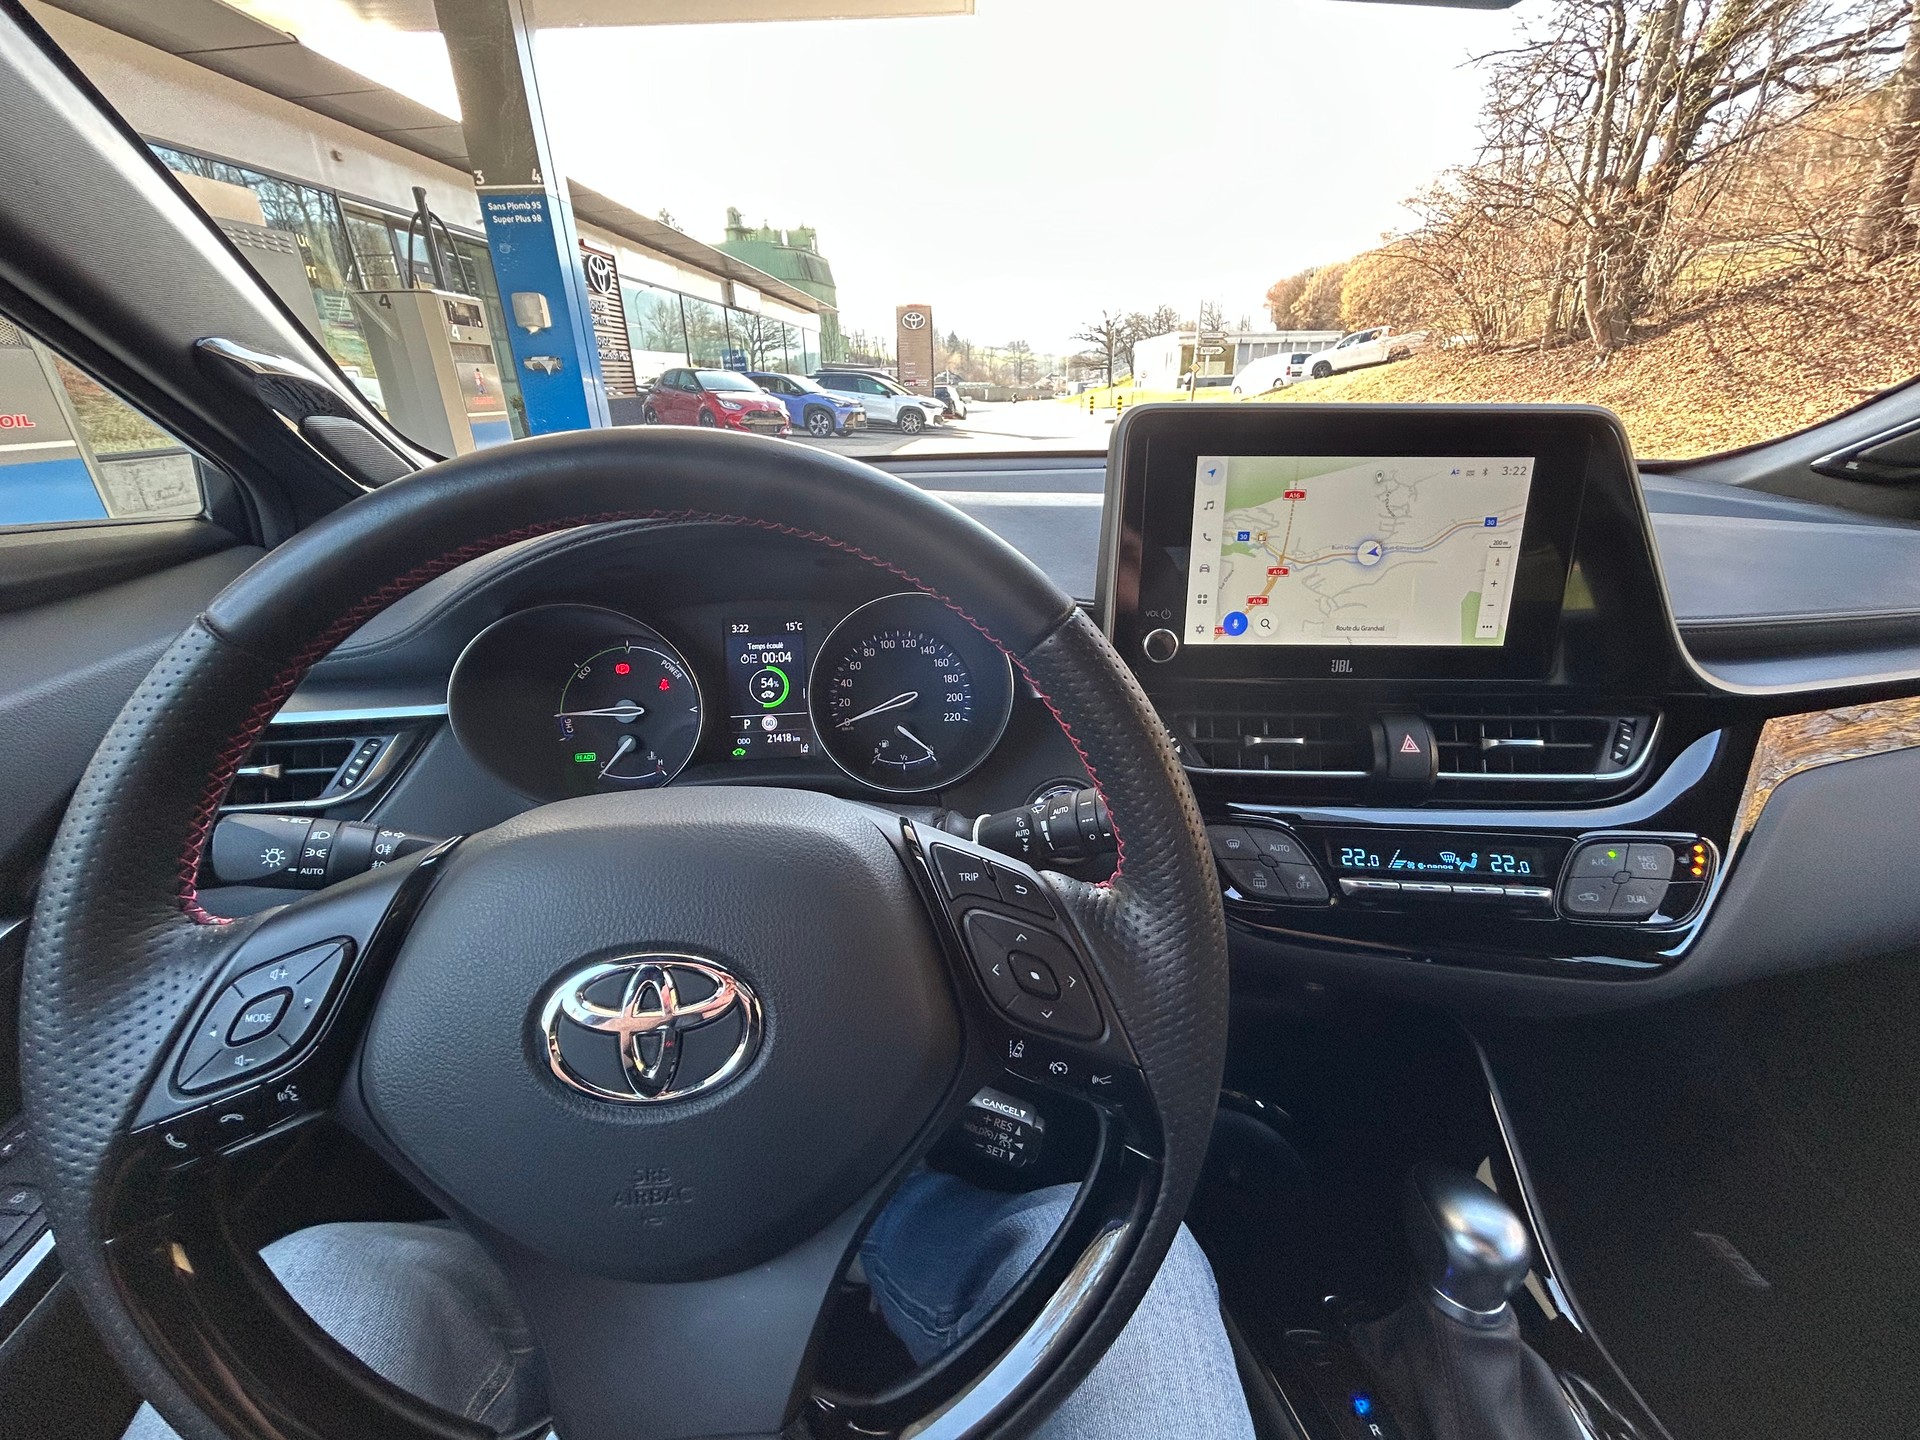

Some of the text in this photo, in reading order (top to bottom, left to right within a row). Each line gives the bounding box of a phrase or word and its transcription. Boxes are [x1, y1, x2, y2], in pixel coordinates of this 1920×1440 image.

[473, 169, 485, 184] 3
[531, 168, 542, 183] 4
[487, 201, 542, 211] Sans Plomb 95
[492, 214, 542, 225] Super Plus 98
[378, 293, 392, 309] 4
[452, 324, 461, 341] 4
[1202, 347, 1220, 356] Village
[0, 414, 36, 429] OIL
[1501, 465, 1528, 476] 3:22
[1145, 610, 1159, 618] VOL
[731, 624, 749, 633] 3:22
[785, 621, 803, 631] 15°C
[747, 641, 784, 651] Temps écoulé
[879, 640, 896, 649] 100
[901, 639, 917, 649] 120
[863, 648, 876, 657] 80
[920, 646, 936, 655] 140
[761, 651, 792, 664] 00:04
[934, 658, 949, 667] 160
[660, 659, 682, 680] POWER
[849, 661, 862, 670] 60
[1331, 659, 1353, 673] JBL
[577, 666, 591, 680] ECO
[760, 677, 780, 688] 54%
[840, 678, 853, 687] 40
[943, 674, 959, 683] 180
[838, 698, 851, 707] 20
[946, 693, 963, 702] 200
[943, 712, 961, 722] 220
[564, 718, 574, 733] CHG
[743, 718, 751, 730] P
[765, 719, 774, 727] 60
[736, 737, 751, 745] ODO
[767, 732, 792, 743] 21418
[1052, 805, 1069, 816] AUTO
[1015, 828, 1030, 838] AUTO
[1269, 843, 1290, 853] AUTO
[1340, 847, 1380, 868] 22.0
[1591, 858, 1607, 867] A/C
[1488, 853, 1531, 874] 22.0
[1640, 862, 1658, 871] ECO
[300, 867, 325, 876] AUTO
[958, 872, 979, 882] TRIP
[1295, 881, 1312, 890] OFF
[1626, 894, 1649, 904] DUAL
[244, 1013, 273, 1023] MODE
[982, 1098, 1021, 1117] CANCEL
[993, 1117, 1014, 1132] RES
[986, 1144, 1007, 1158] SET
[1369, 1423, 1383, 1437] R
